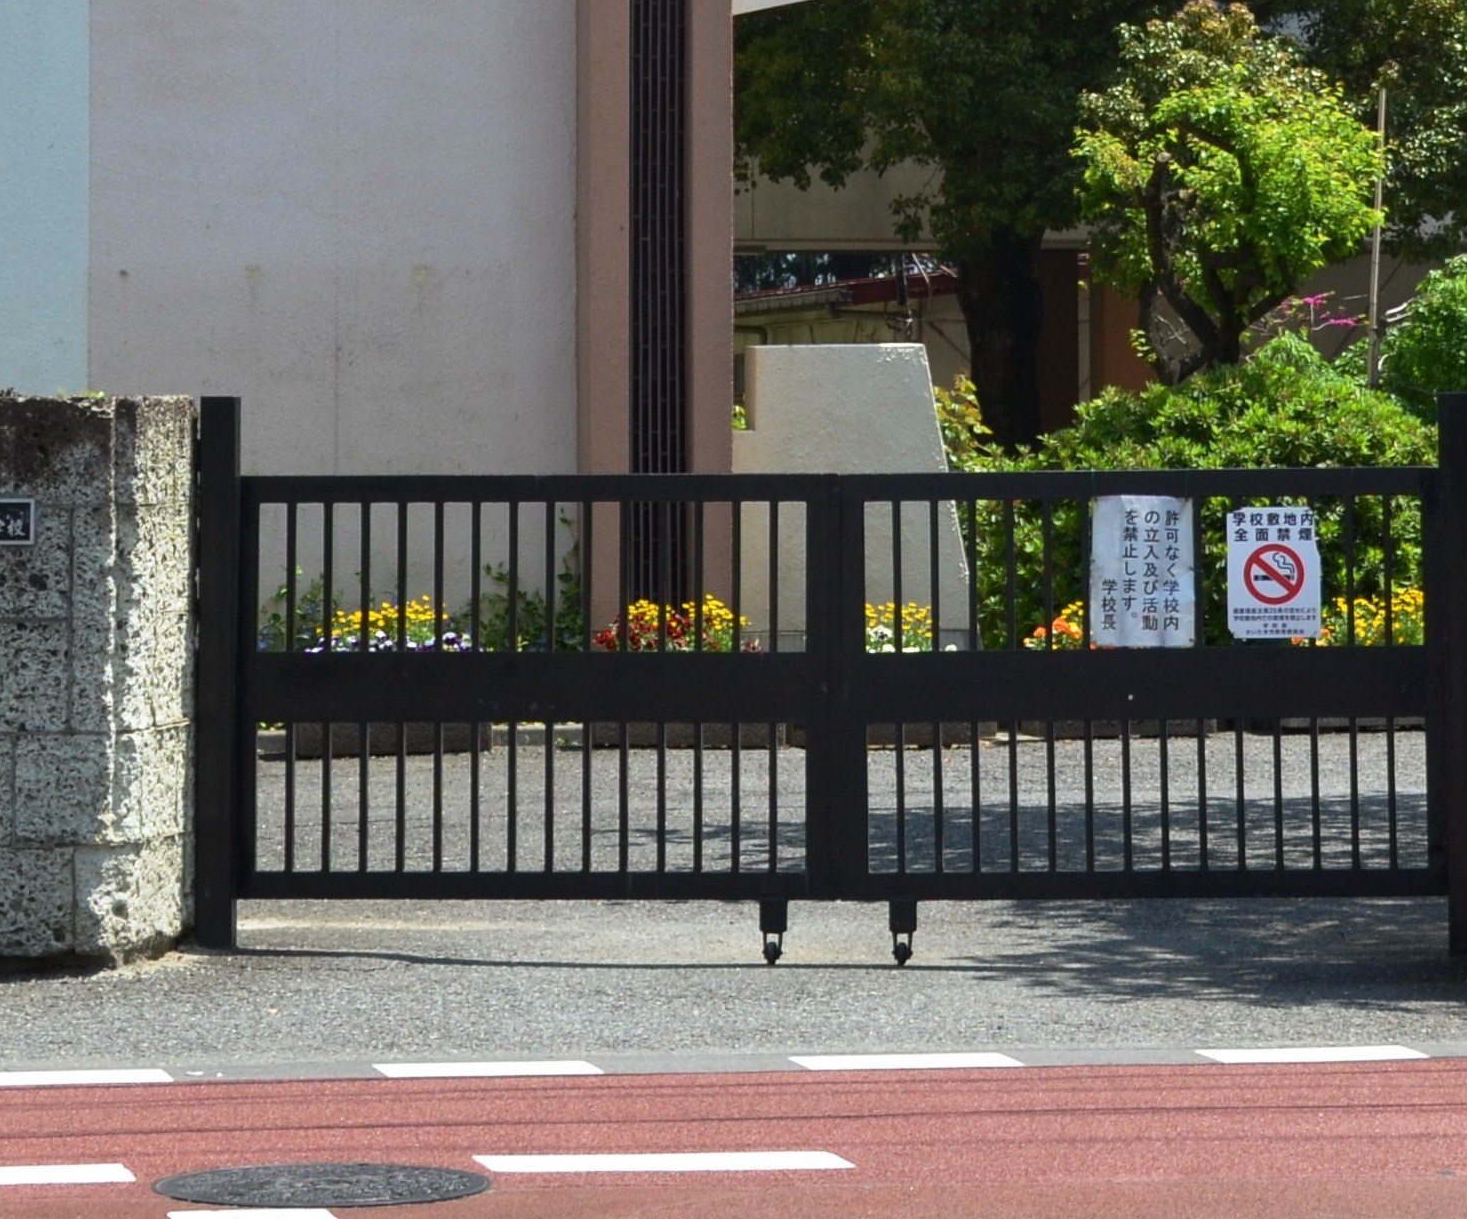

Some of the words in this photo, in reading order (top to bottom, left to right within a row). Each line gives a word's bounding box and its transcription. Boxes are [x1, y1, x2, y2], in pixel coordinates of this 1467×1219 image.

[1233, 512, 1313, 526] 学校敷地内
[1234, 528, 1312, 542] 全面禁煙
[1122, 509, 1138, 618] を禁止します。
[1141, 510, 1160, 631] の立入及び活動
[1163, 510, 1180, 631] 許可なく学校内
[1101, 579, 1118, 630] 学校長
